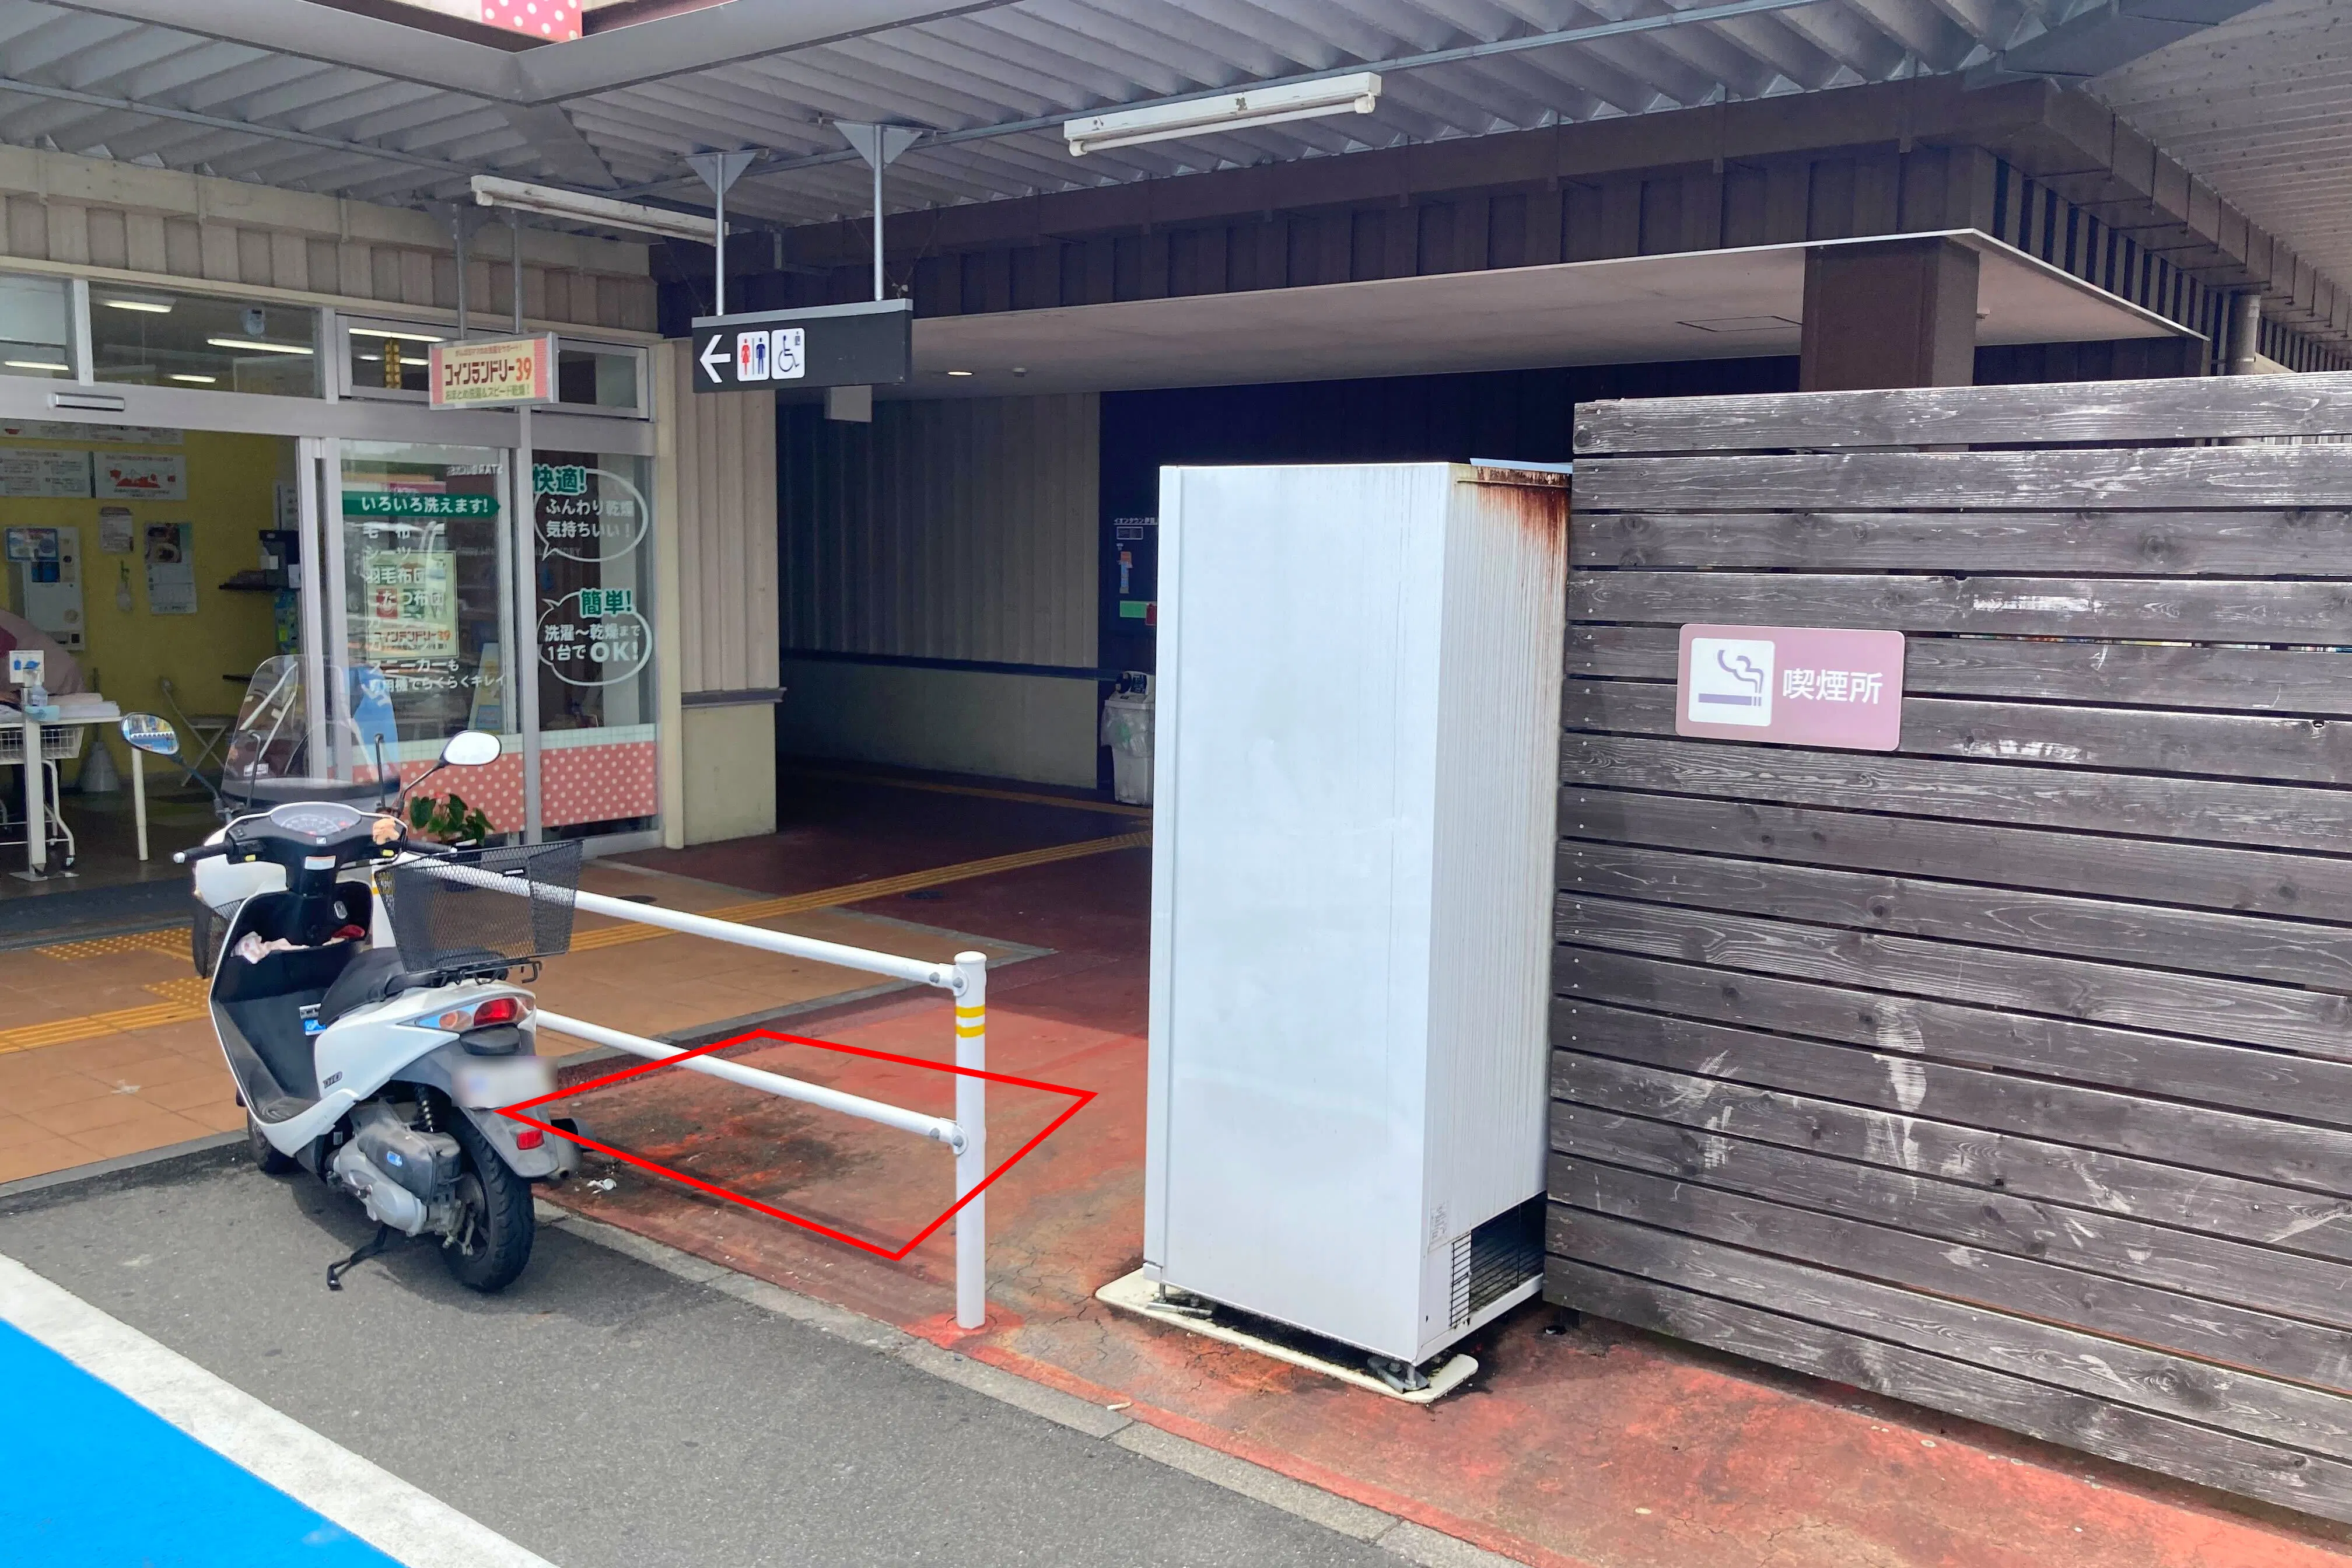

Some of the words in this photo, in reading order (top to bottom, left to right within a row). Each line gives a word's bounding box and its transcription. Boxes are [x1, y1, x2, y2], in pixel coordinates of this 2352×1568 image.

[445, 357, 532, 386] コインランドリー39
[533, 465, 587, 494] 快適!
[362, 496, 488, 513] いろいろ洗えます!
[546, 499, 635, 517] ふんわり乾燥
[580, 589, 632, 616] 簡単!
[1782, 668, 1884, 705] 喫煙所
